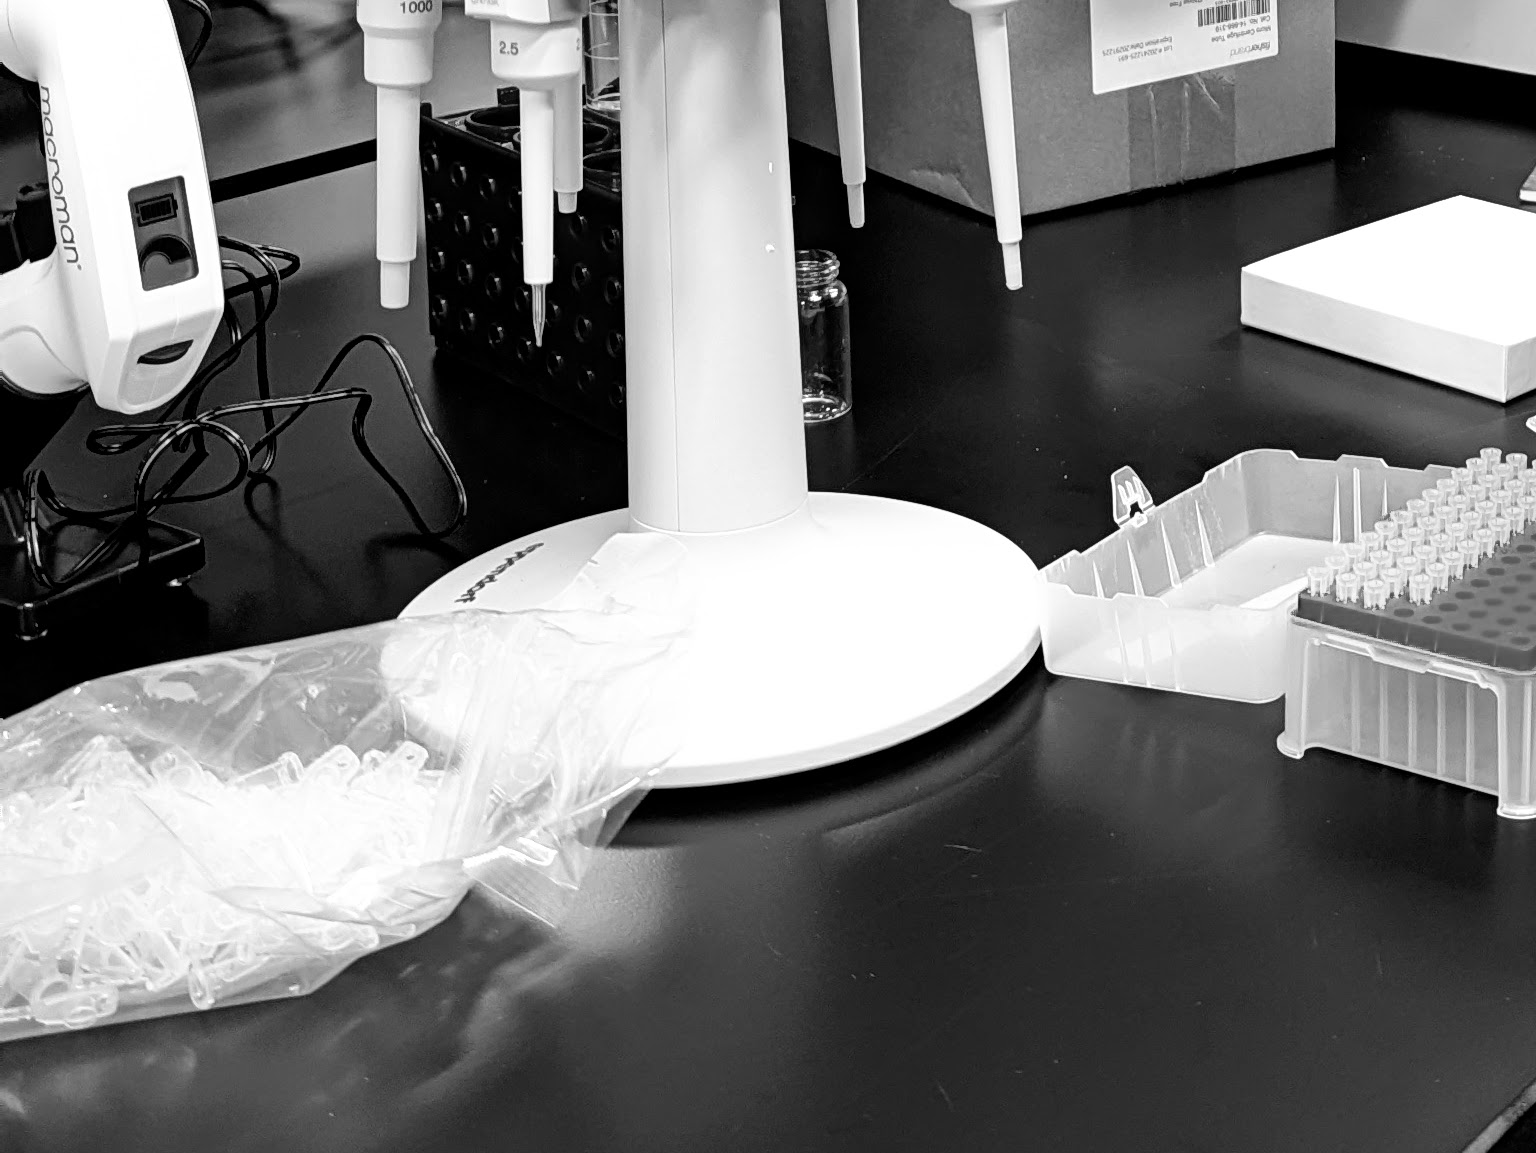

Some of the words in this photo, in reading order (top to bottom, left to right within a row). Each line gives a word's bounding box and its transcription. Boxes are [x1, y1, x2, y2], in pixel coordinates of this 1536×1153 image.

[399, 0, 434, 15] 1000
[1226, 28, 1254, 39] Centrifuge
[499, 40, 520, 56] 2.5
[1229, 42, 1270, 57] fisherbrand
